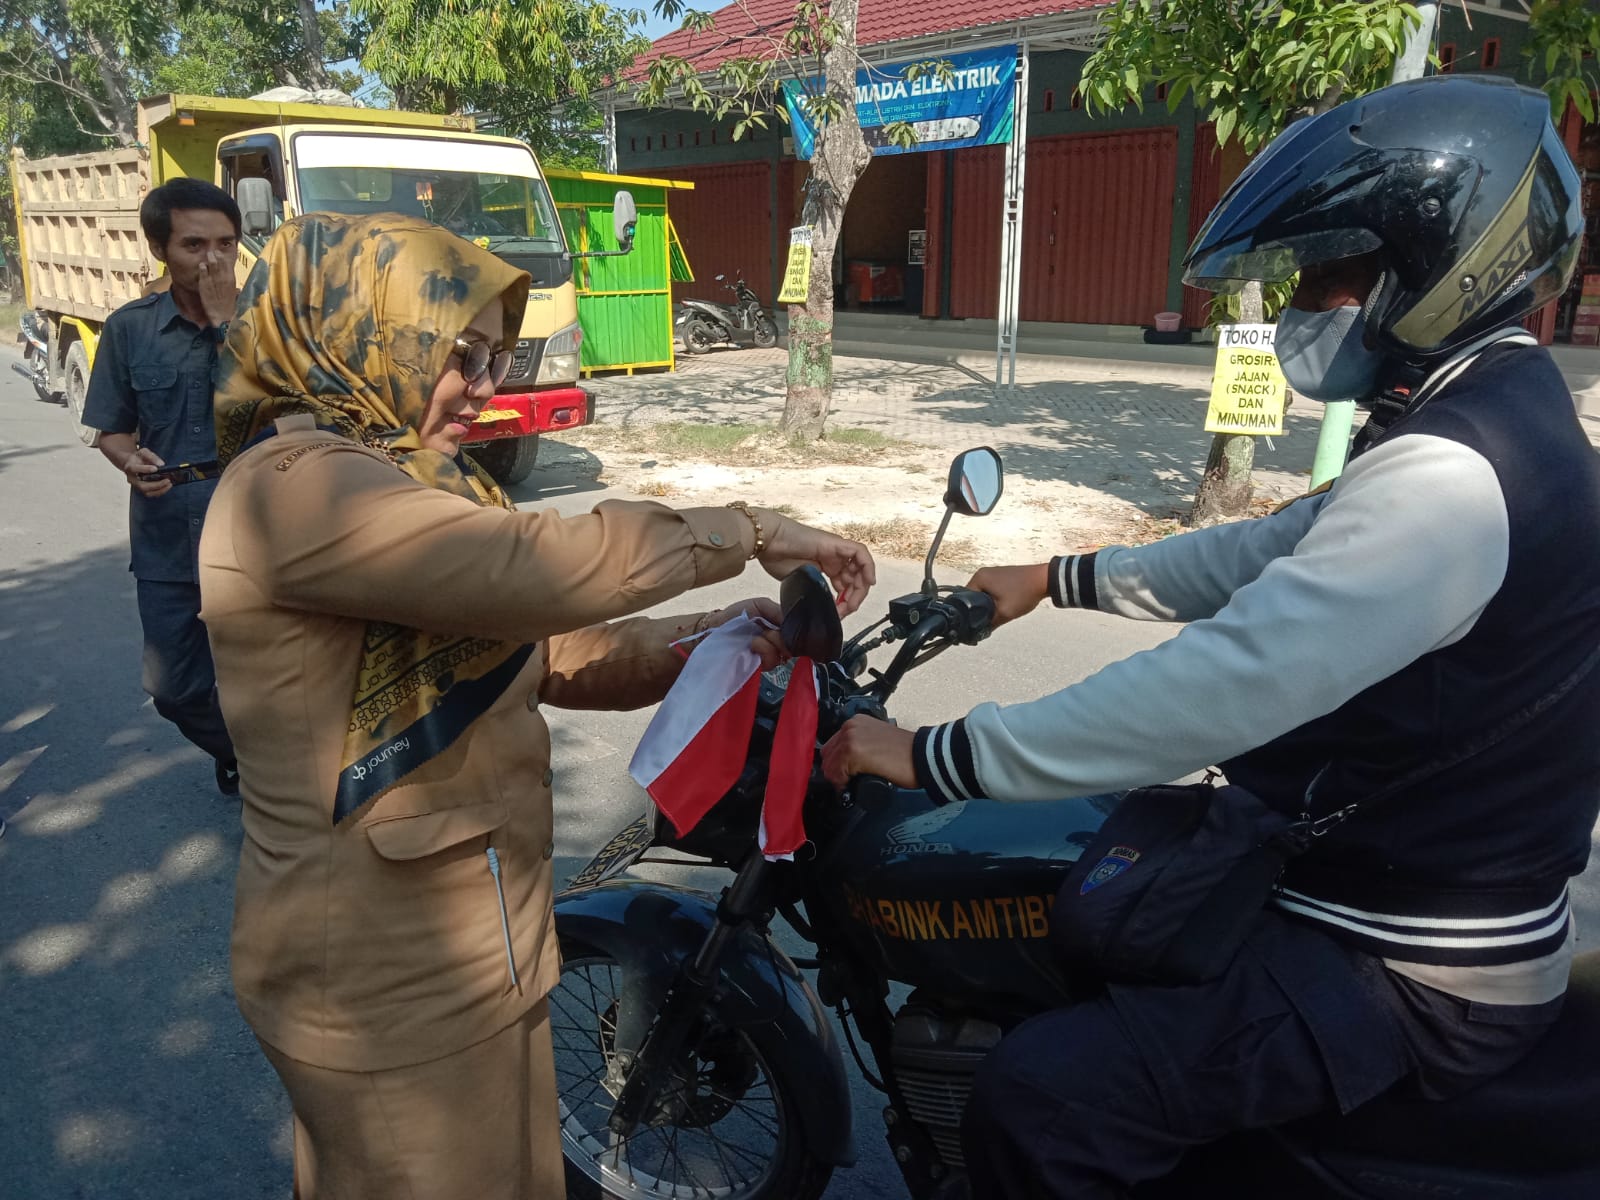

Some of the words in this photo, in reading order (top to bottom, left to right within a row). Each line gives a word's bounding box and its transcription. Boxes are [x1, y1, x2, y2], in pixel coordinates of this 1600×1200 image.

[1225, 329, 1259, 345] TOKO
[1230, 354, 1277, 367] GROSIR:
[1234, 371, 1270, 383] JAJAN
[1238, 398, 1264, 409] DAN
[1216, 411, 1277, 429] MINUMAN
[367, 736, 411, 774] journey
[880, 842, 953, 855] HONDA
